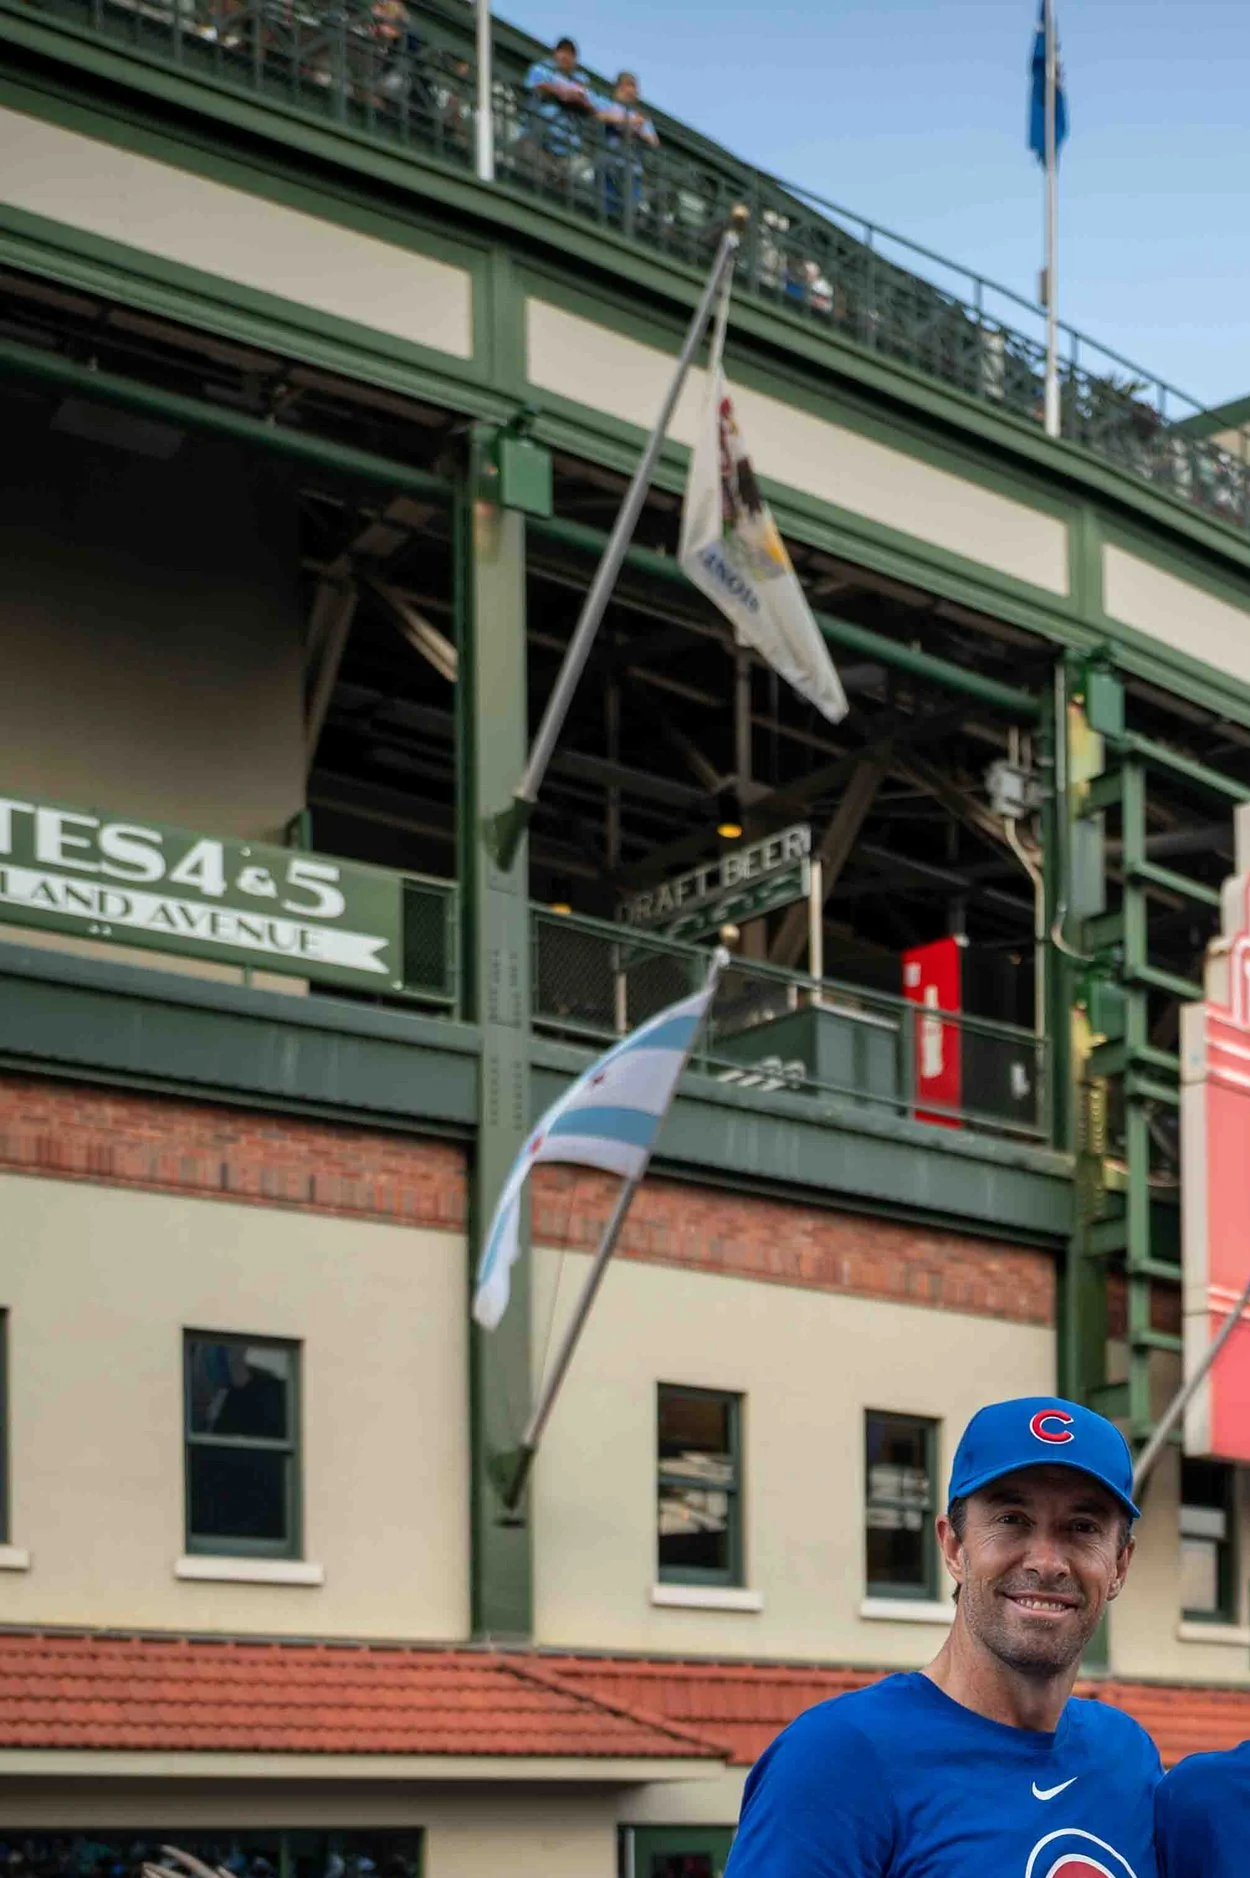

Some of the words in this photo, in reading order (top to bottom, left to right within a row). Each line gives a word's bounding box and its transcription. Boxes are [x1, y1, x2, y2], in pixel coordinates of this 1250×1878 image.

[719, 822, 812, 888] BEER
[149, 902, 321, 954] AVENUE
[1030, 1409, 1074, 1444] C
